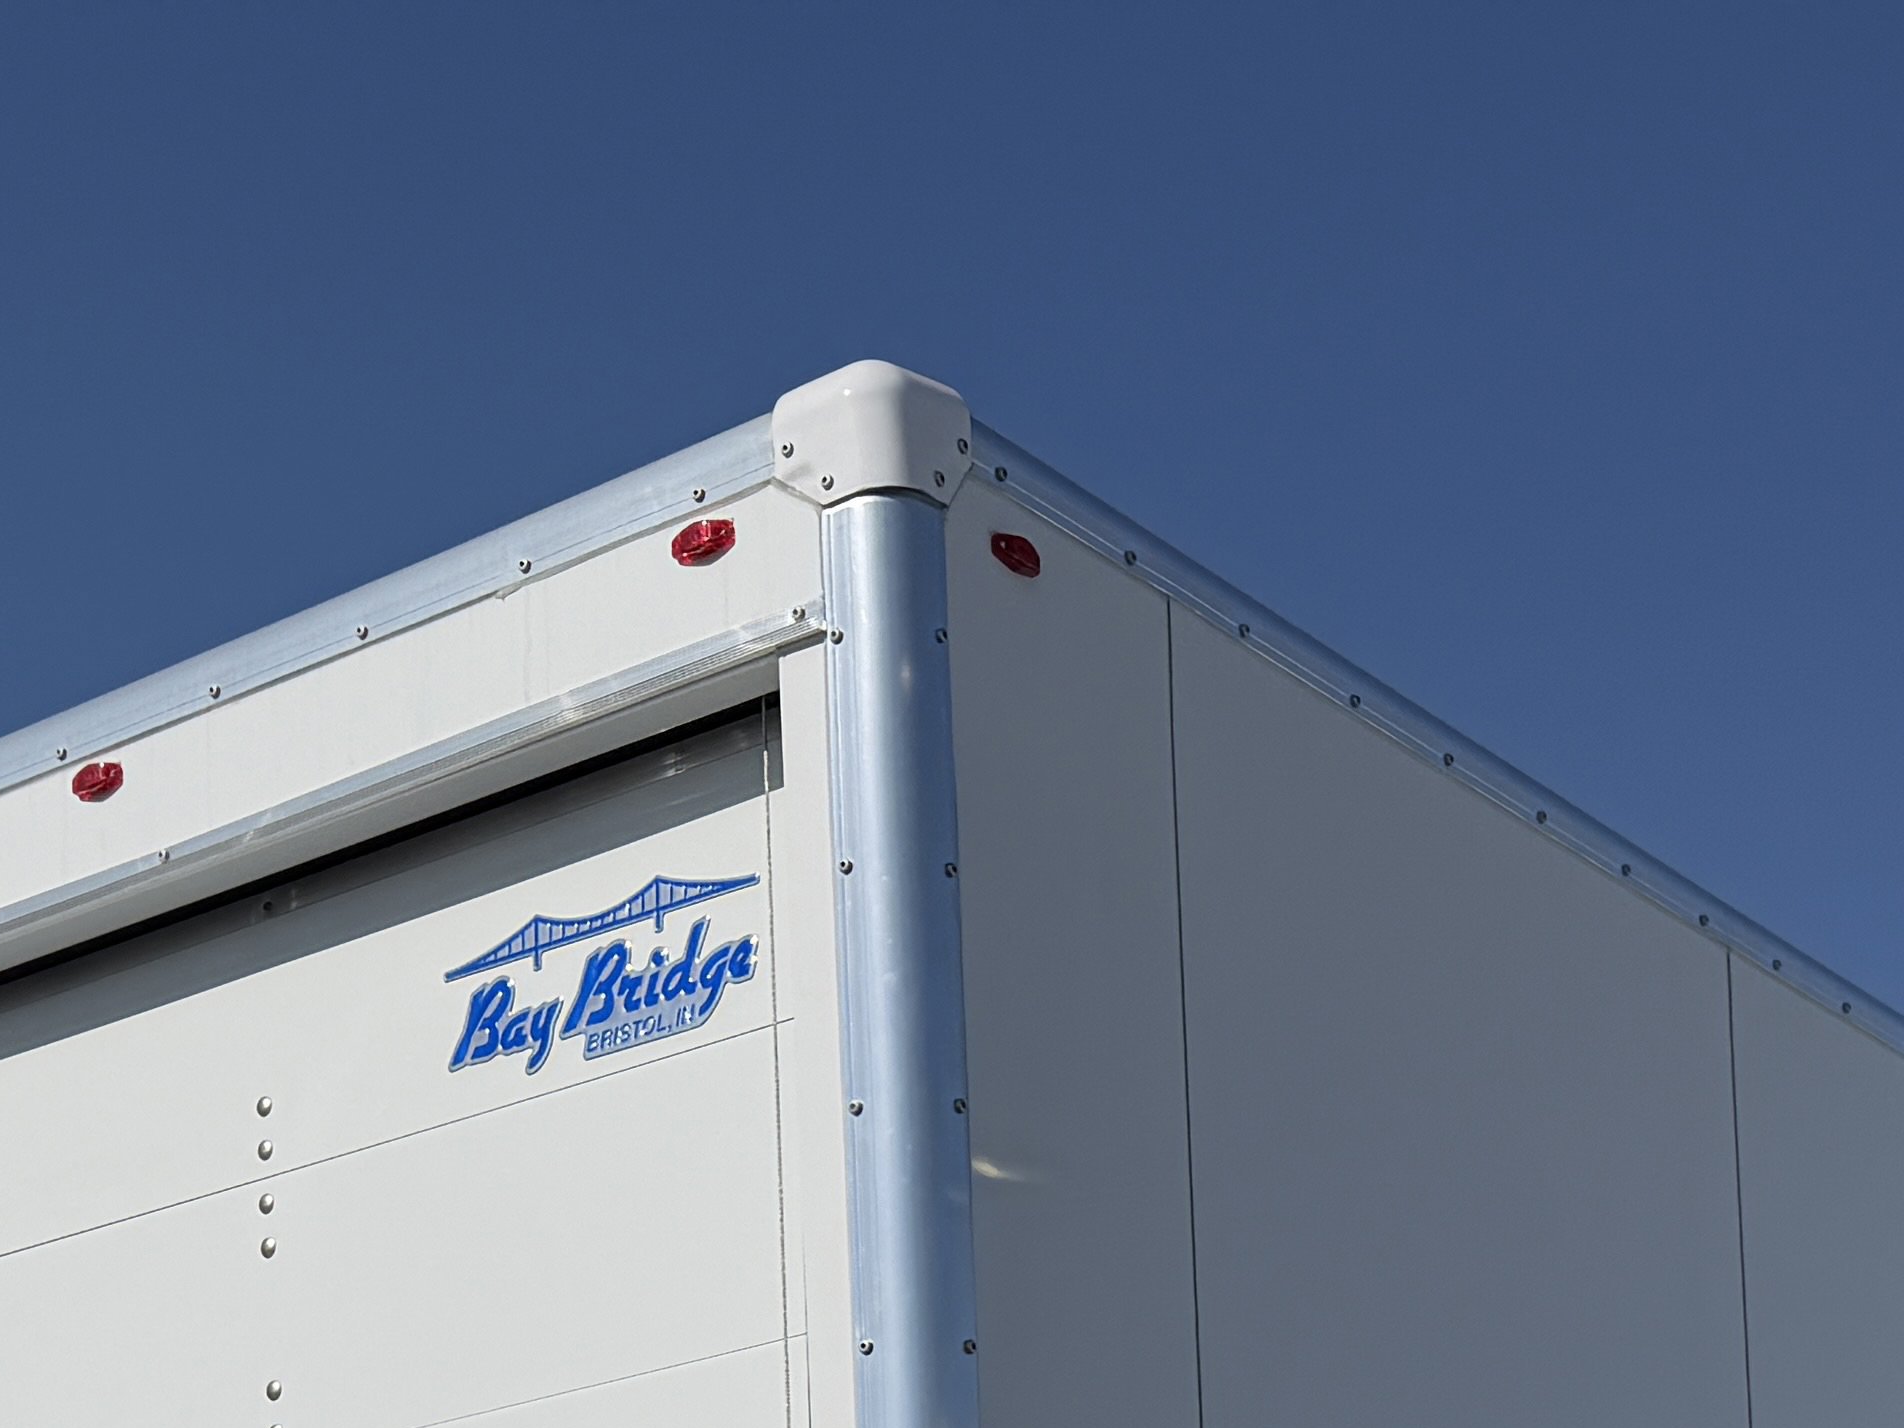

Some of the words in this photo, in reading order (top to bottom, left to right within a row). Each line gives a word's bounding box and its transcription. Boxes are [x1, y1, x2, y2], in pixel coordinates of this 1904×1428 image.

[449, 978, 563, 1075] Bay
[560, 914, 759, 1039] Bridge
[587, 1013, 673, 1053] BRISTOL,
[676, 1003, 696, 1027] IN
